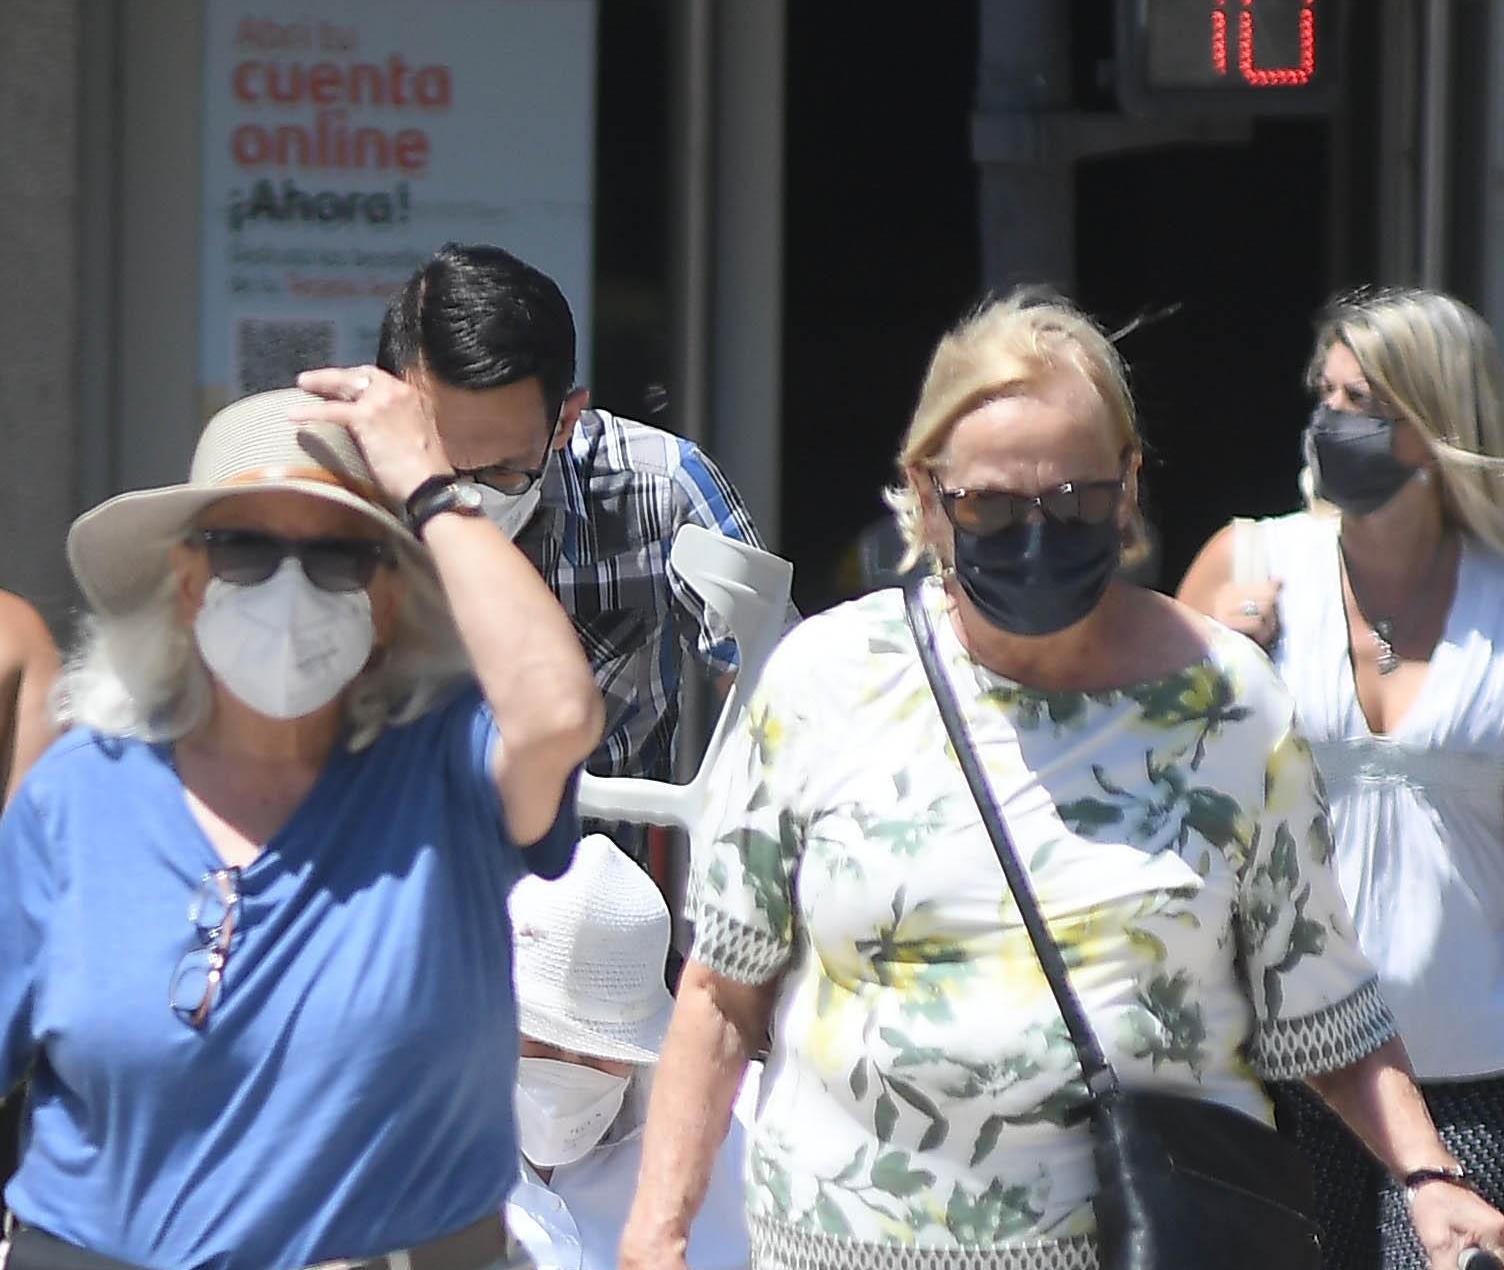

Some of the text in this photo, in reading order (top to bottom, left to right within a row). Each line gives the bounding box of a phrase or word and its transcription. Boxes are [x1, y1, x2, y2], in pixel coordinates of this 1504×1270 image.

[232, 54, 452, 107] cuenta
[232, 110, 430, 170] online
[229, 179, 411, 232] ¡Ahora!
